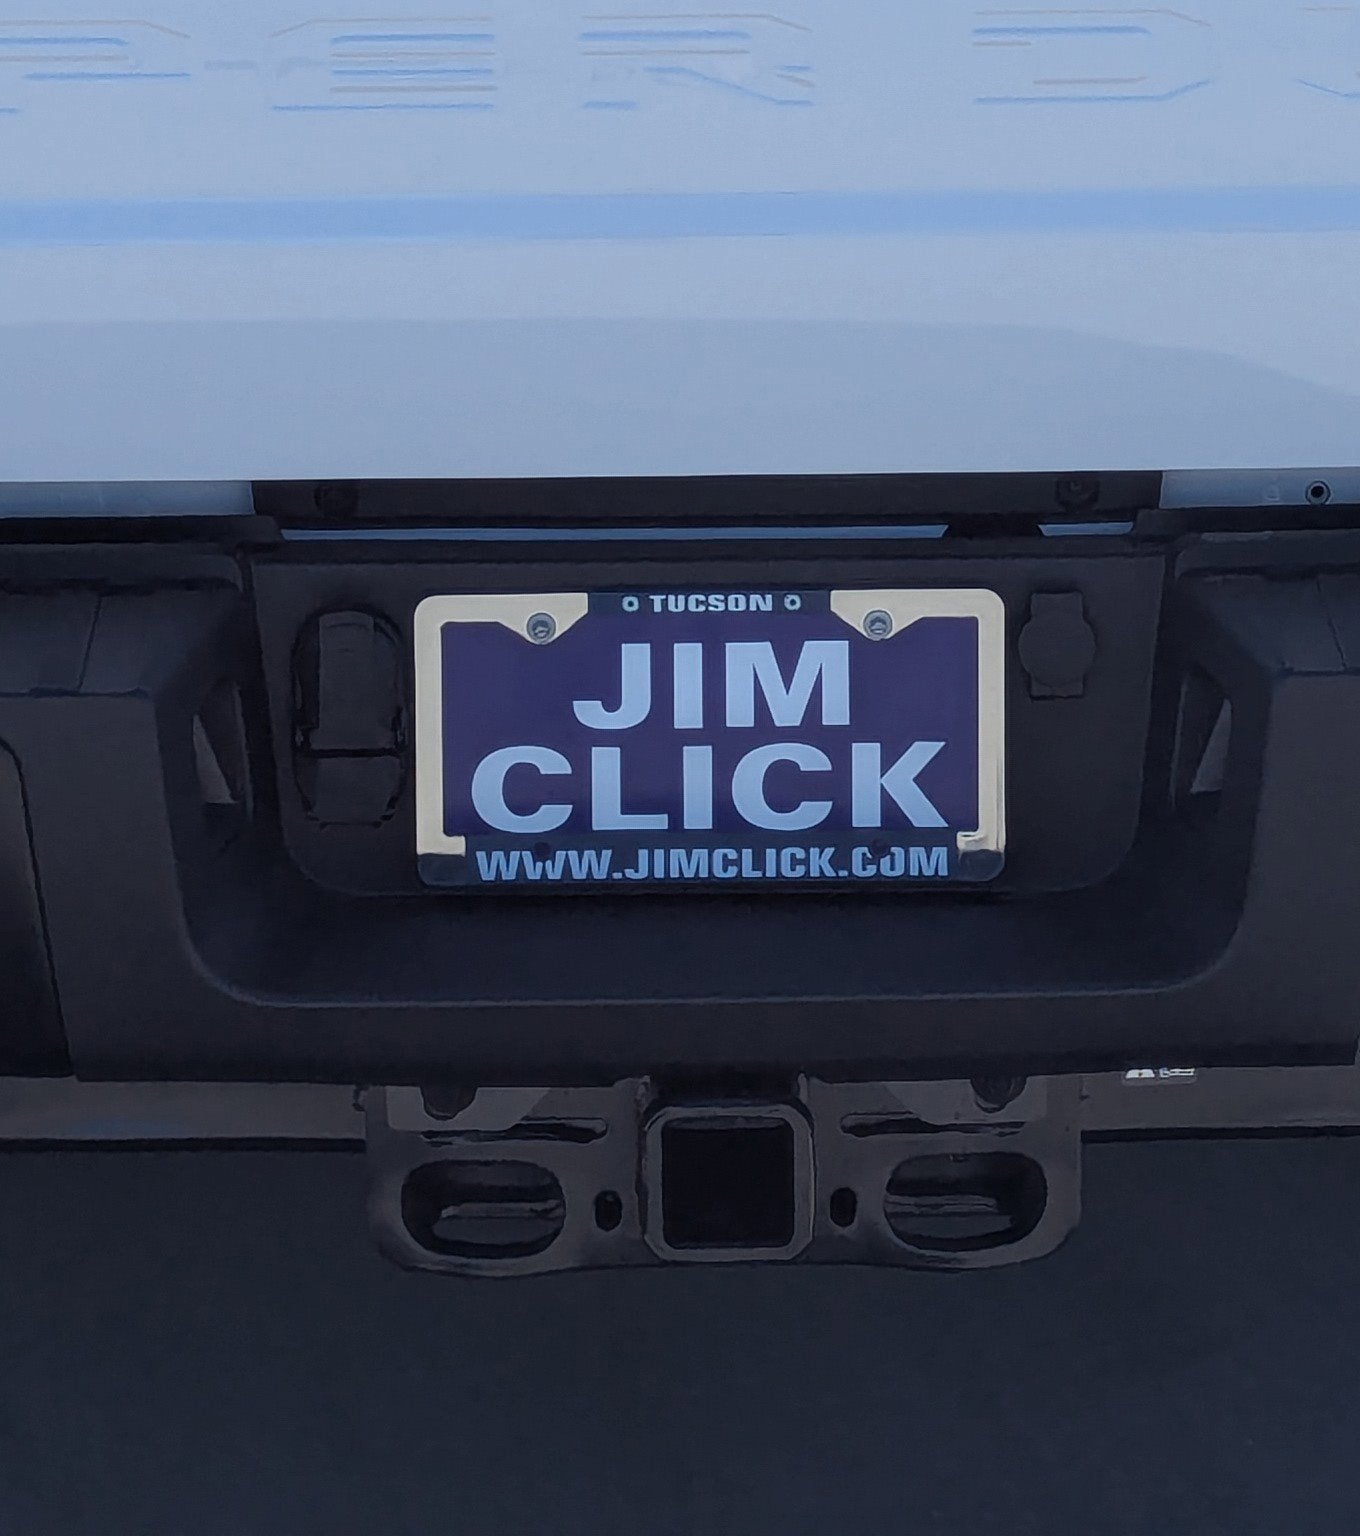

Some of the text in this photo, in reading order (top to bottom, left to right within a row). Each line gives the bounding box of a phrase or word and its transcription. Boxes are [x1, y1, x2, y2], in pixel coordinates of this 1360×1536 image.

[649, 594, 773, 612] TUCSON
[573, 640, 851, 730] JIM
[471, 741, 949, 833] CLICK
[476, 846, 948, 881] WWW.JIMCLICK.COM
